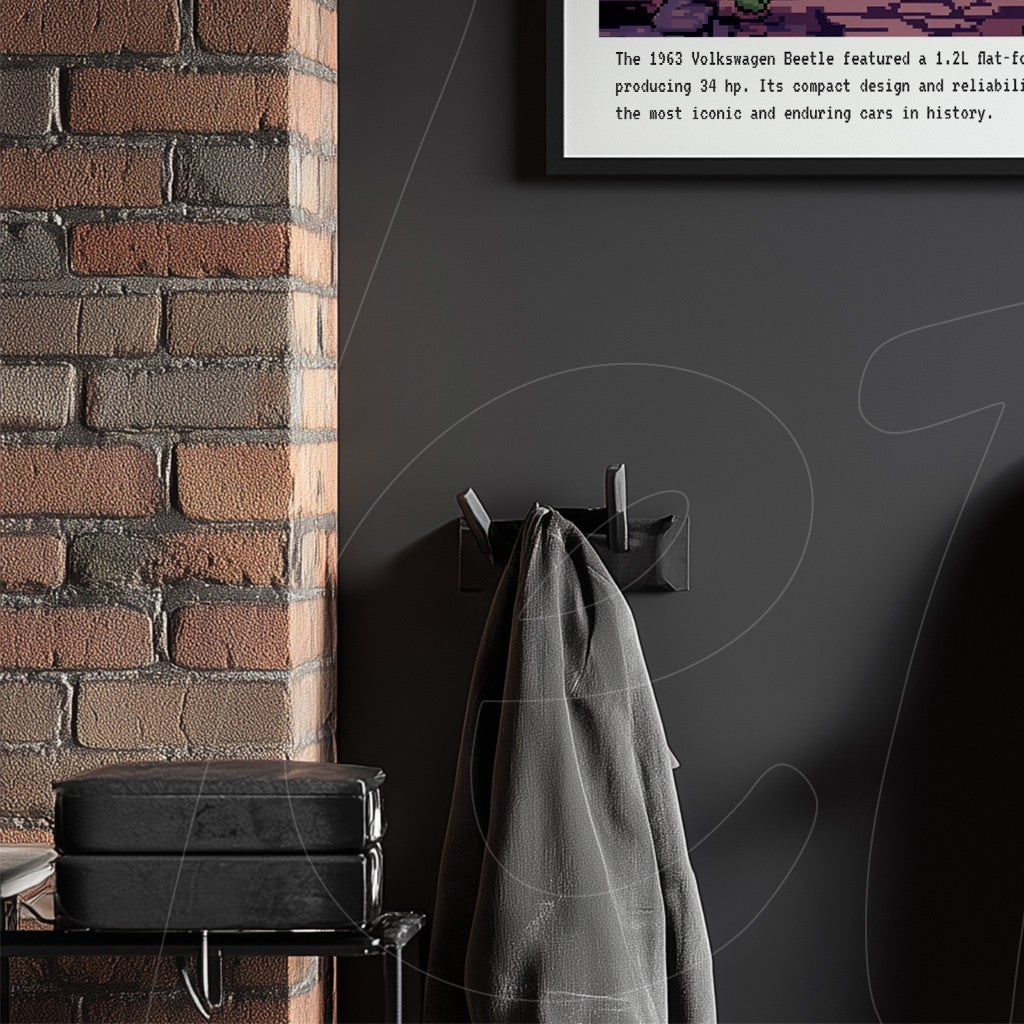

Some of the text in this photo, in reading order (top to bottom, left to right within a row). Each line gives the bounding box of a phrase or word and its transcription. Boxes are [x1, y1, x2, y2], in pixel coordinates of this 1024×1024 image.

[615, 51, 641, 66] The
[650, 51, 683, 66] 1963
[691, 51, 776, 69] Volkswagen
[783, 51, 834, 66] Beetle
[843, 50, 910, 66] featured
[918, 54, 927, 66] a
[936, 50, 969, 66] 1.2L
[615, 78, 692, 97] producing
[700, 78, 717, 93] 34
[724, 78, 748, 97] hp.
[760, 78, 784, 93] Its
[792, 78, 851, 97] compact
[859, 78, 910, 97] design
[918, 78, 944, 93] and
[615, 105, 992, 124] the most iconic and enduring cars in history.
